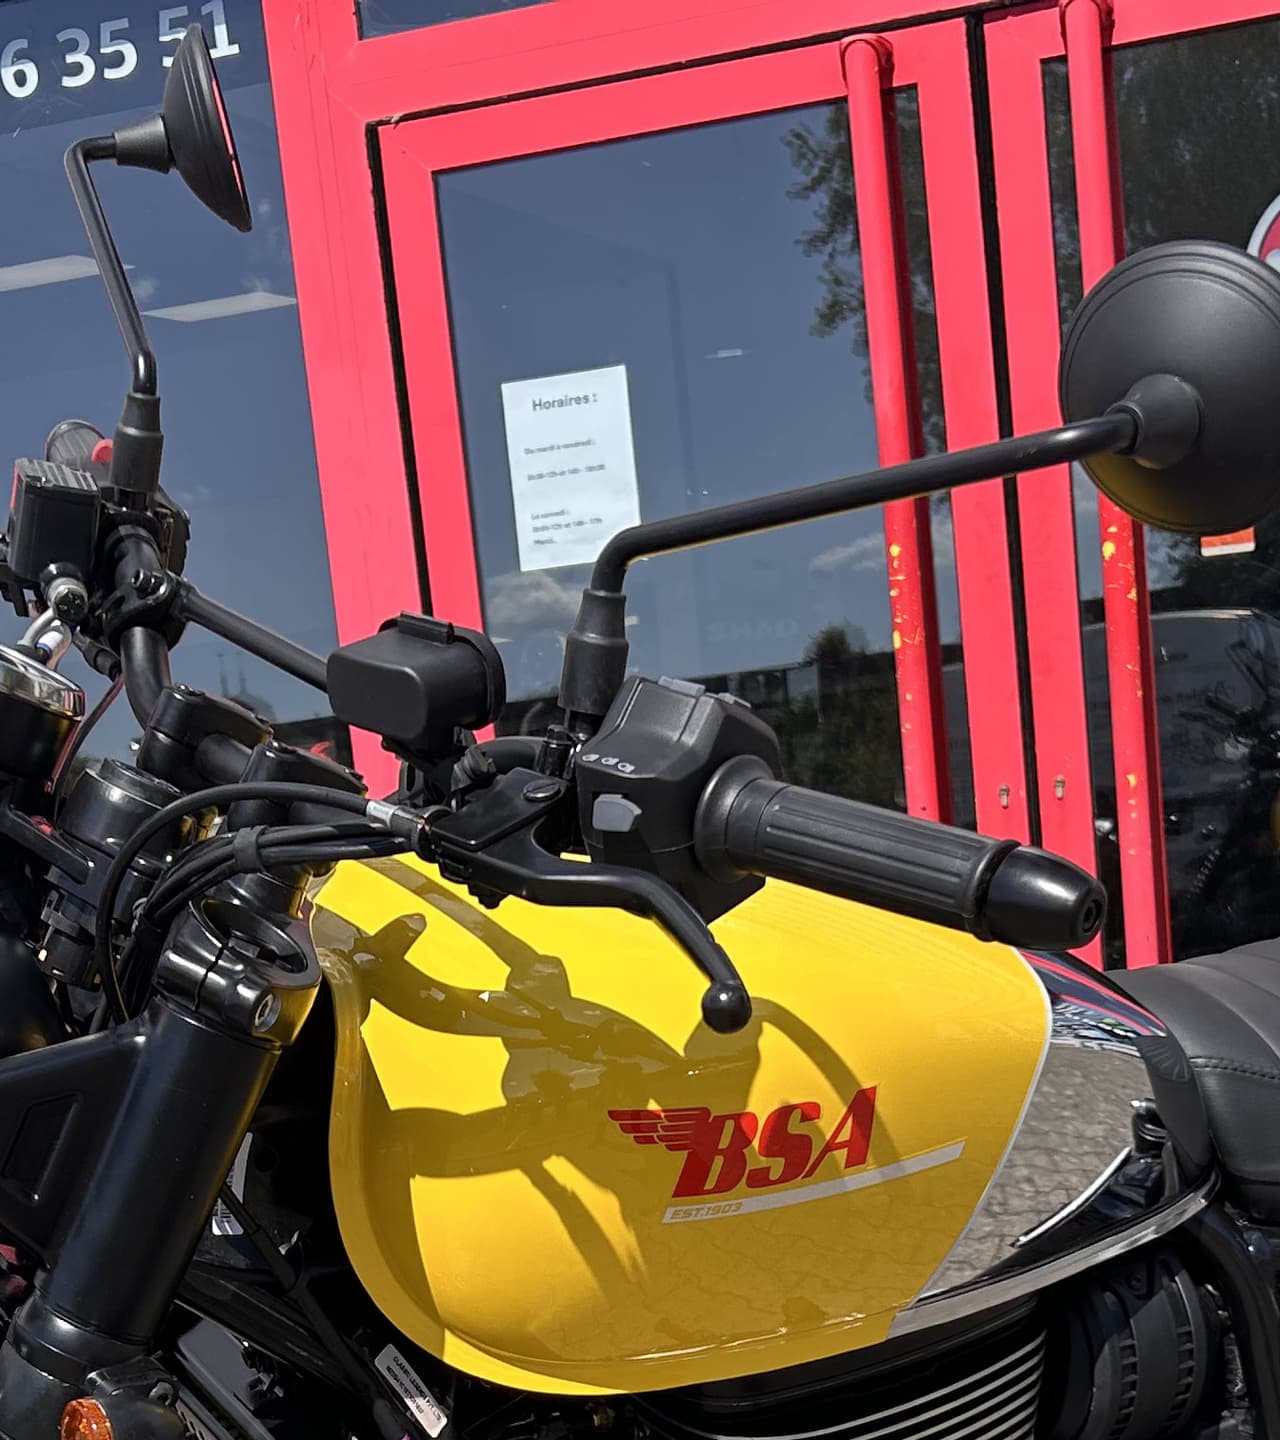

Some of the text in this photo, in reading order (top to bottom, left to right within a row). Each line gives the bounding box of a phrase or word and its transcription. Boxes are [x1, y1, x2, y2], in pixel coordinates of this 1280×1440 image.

[56, 17, 140, 88] 35
[158, 0, 240, 69] 51
[532, 393, 589, 412] Horaires
[608, 1085, 877, 1198] BSA
